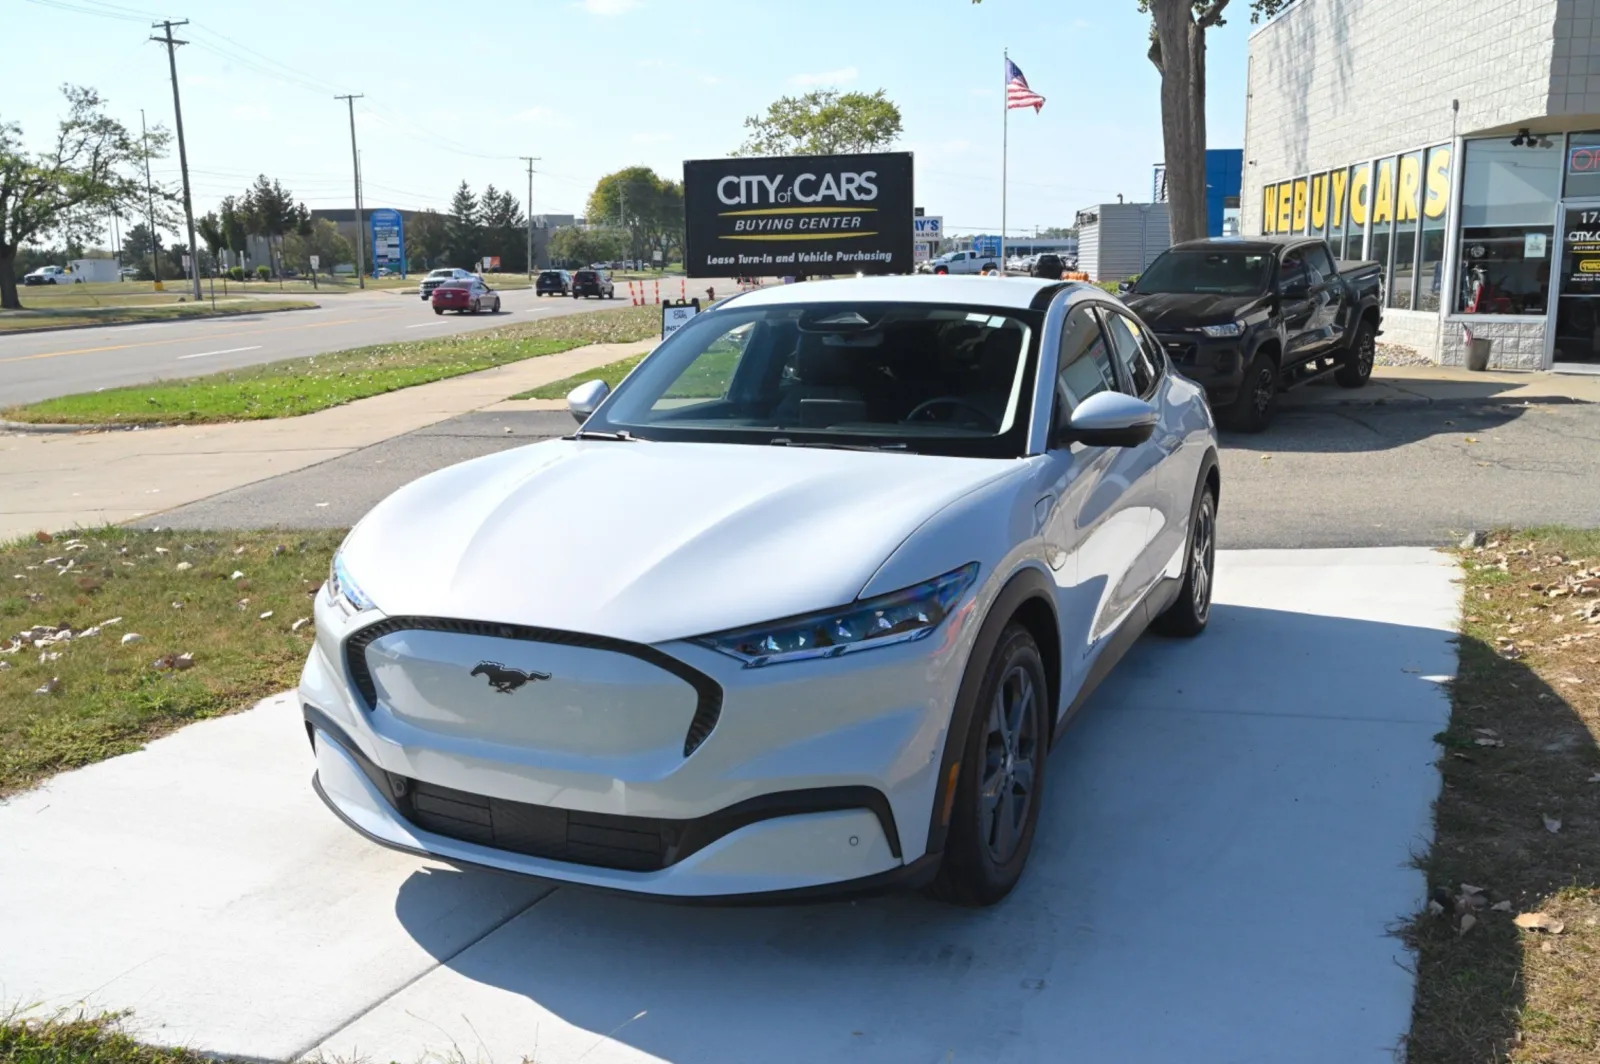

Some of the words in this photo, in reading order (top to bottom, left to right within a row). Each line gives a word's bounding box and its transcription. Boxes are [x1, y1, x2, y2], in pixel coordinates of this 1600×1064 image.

[717, 174, 784, 205] CITY
[777, 187, 792, 203] of
[793, 171, 878, 202] CARS
[735, 218, 794, 232] BUYING
[799, 216, 861, 229] CENTER
[707, 254, 735, 265] Lease
[738, 253, 772, 264] Turn-In
[776, 252, 794, 263] and
[798, 251, 833, 263] Vehicle
[836, 251, 892, 263] Purchasing
